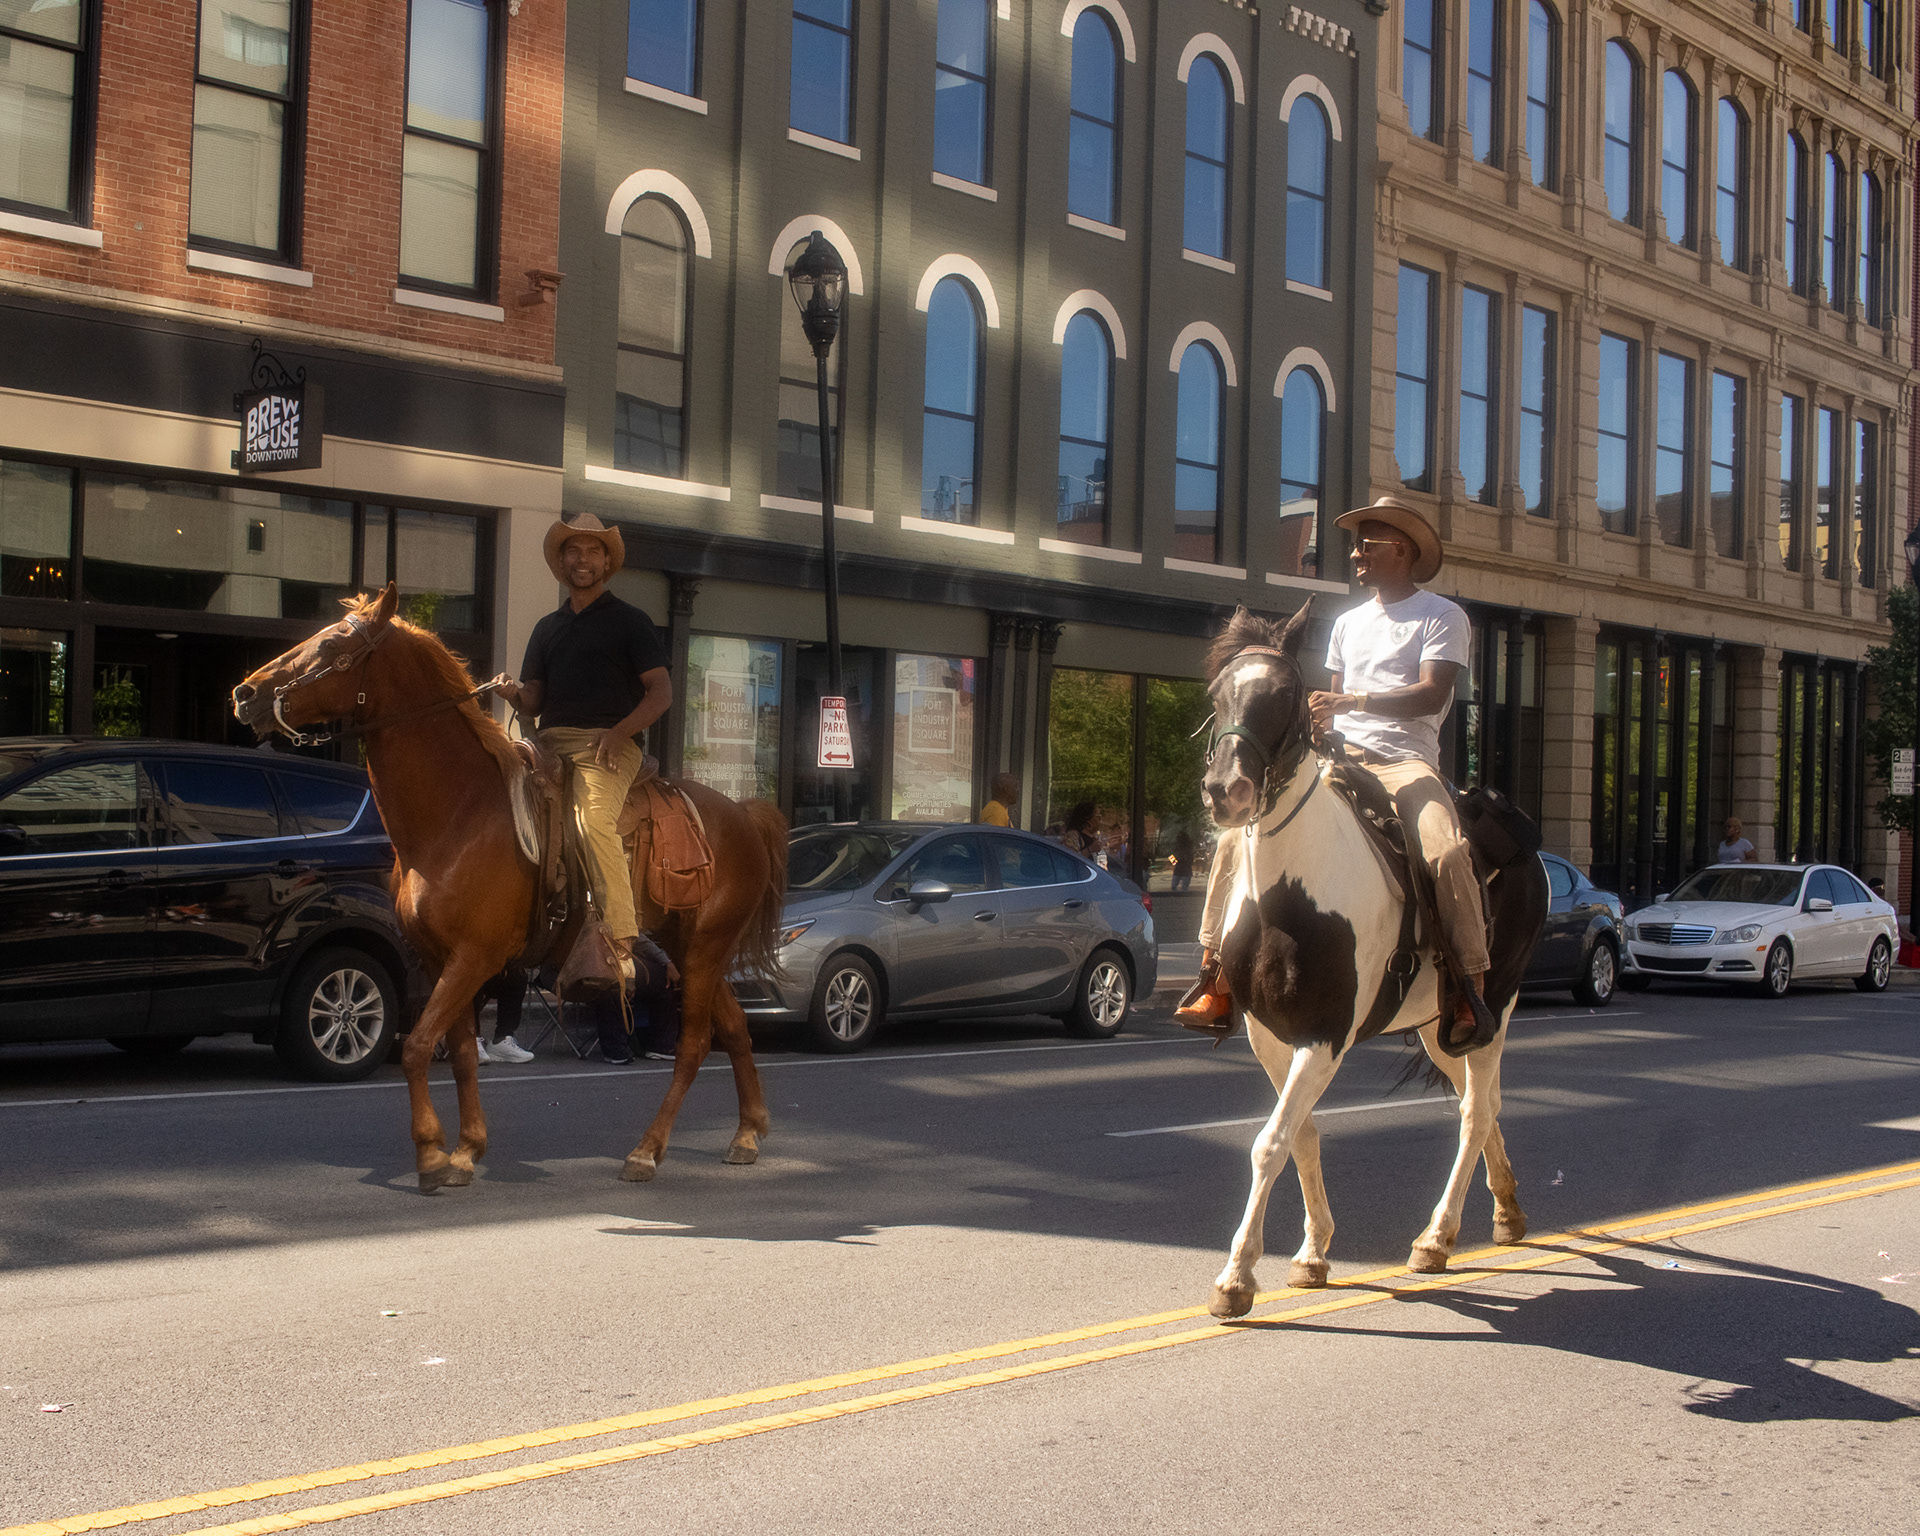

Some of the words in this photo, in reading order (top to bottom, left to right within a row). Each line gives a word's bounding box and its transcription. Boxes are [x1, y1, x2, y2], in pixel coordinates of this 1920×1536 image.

[247, 395, 299, 441] BREW
[246, 447, 299, 463] DOWNTOWN
[722, 686, 743, 697] FORT
[712, 702, 752, 713] INDUSTRY
[924, 700, 942, 710] FORT
[834, 710, 845, 721] NO
[914, 715, 950, 725] INDUSTRY
[713, 718, 748, 729] SQUARE
[917, 729, 947, 739] SQUARE
[1894, 752, 1900, 760] 2
[696, 763, 720, 771] LUXURY
[721, 763, 765, 773] APARTMENTS
[731, 773, 744, 781] FOR
[744, 773, 766, 781] LEASE
[727, 790, 741, 798] BED
[939, 792, 959, 800] SPACE
[908, 800, 952, 808] OPPORTUNITIES
